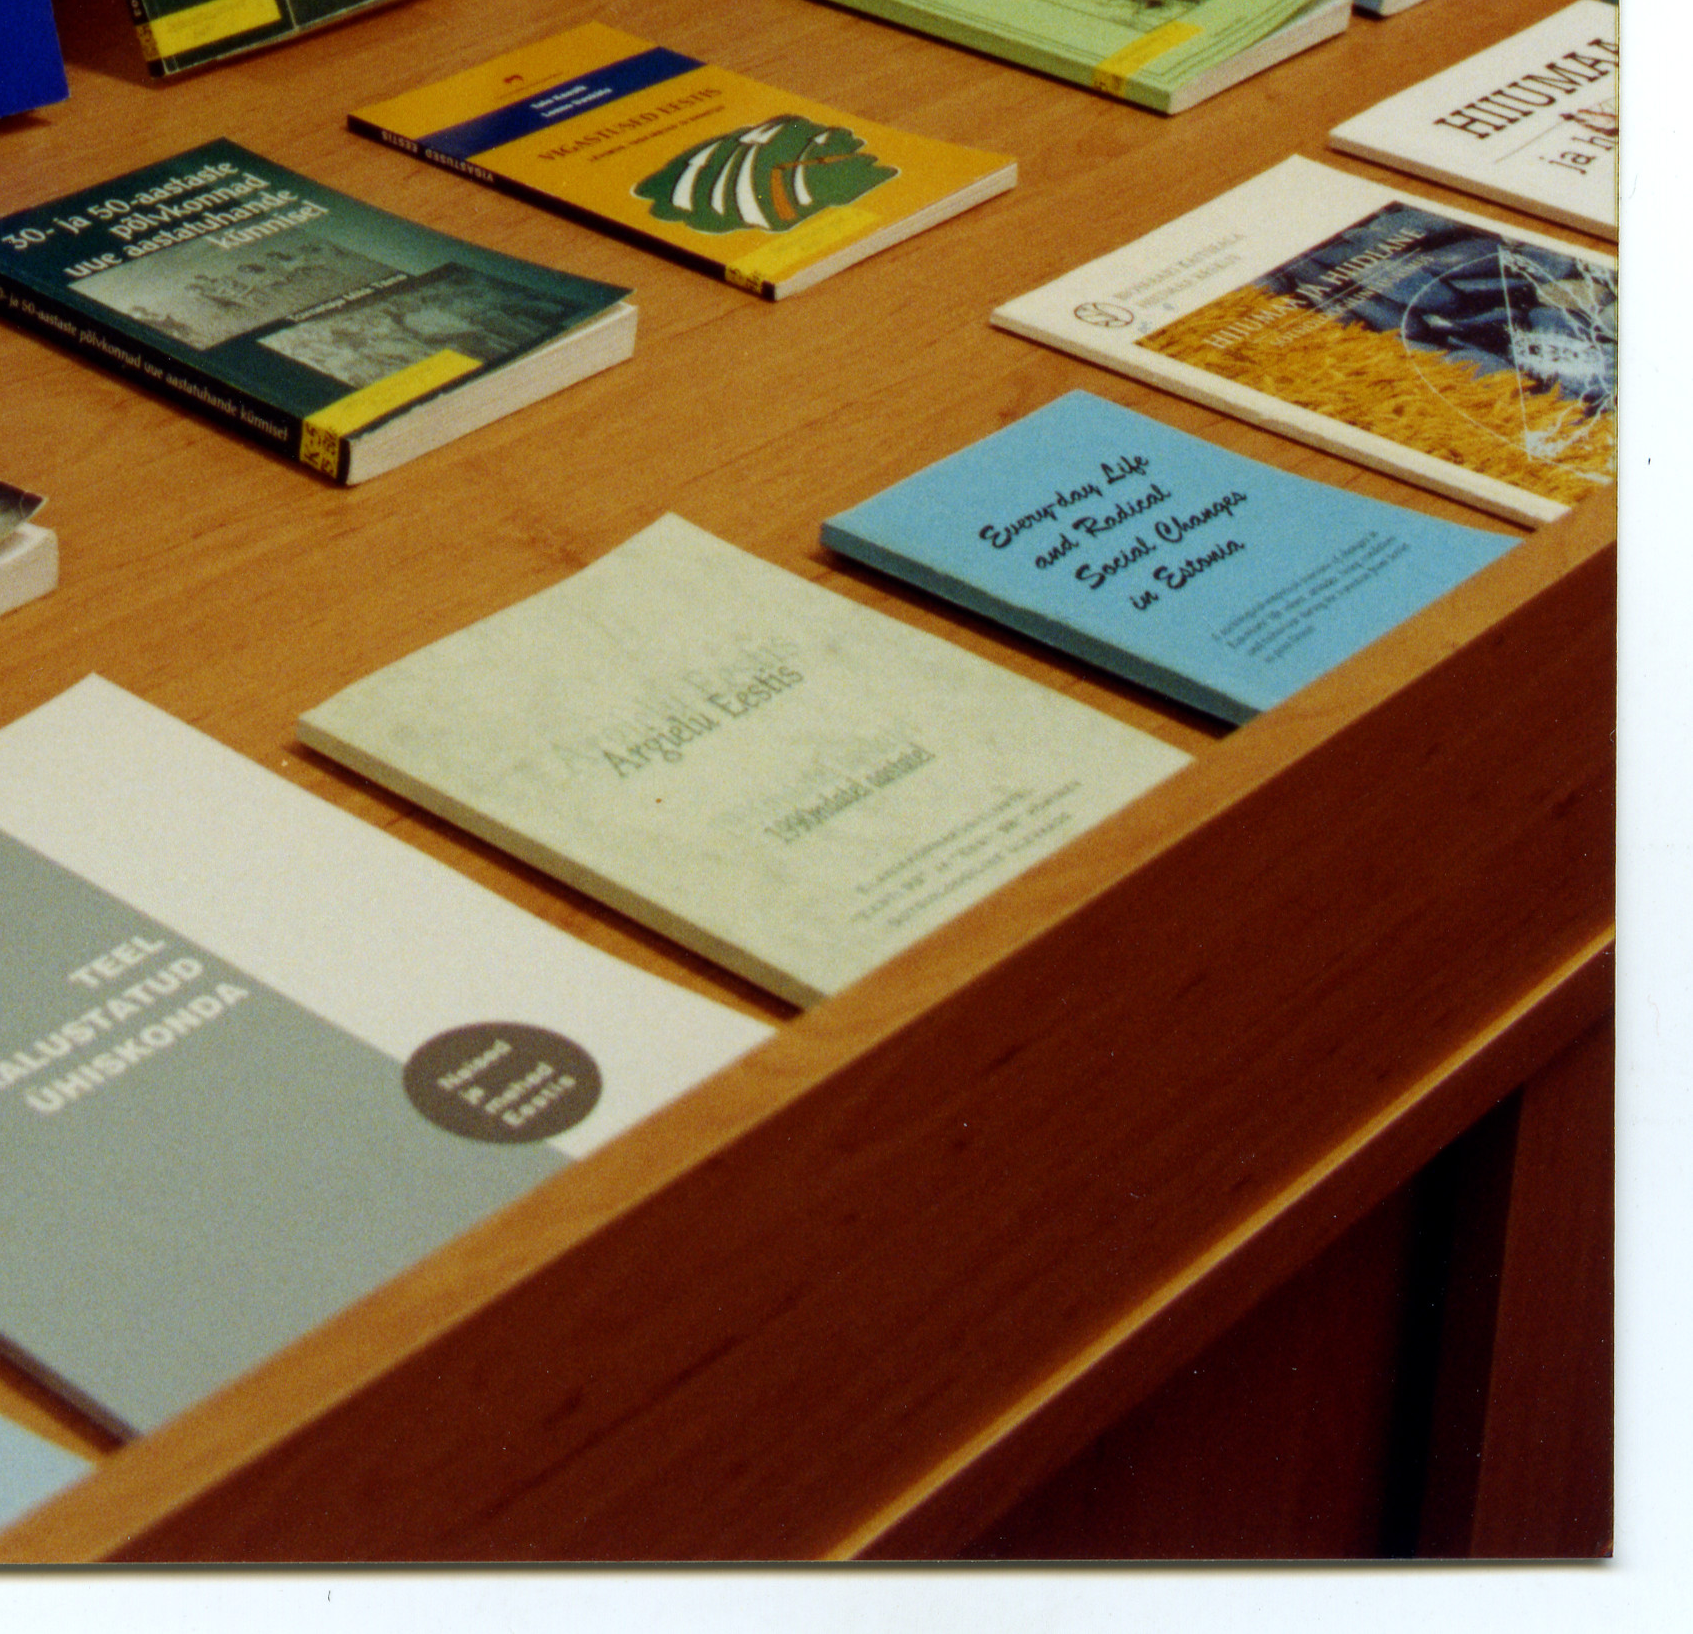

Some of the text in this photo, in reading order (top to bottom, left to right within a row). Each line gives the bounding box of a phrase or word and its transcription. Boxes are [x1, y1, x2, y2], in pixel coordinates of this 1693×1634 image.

[0, 160, 239, 252] 30- ja 50-aastaste
[107, 170, 272, 242] põlvkonnad
[1538, 150, 1597, 176] ja
[62, 187, 299, 279] uue aastatuhande
[205, 197, 330, 251] künnisel
[978, 454, 1150, 550] Every-day Life
[1034, 482, 1173, 570] and Radical
[1073, 490, 1249, 591] Social Changes
[1128, 538, 1247, 612] in Estonia
[603, 713, 721, 780] Argielu
[707, 664, 806, 719] Eestis
[67, 935, 167, 989] TEEL
[22, 981, 250, 1115] ÜHISKONDA
[501, 1073, 577, 1128] Eestis
